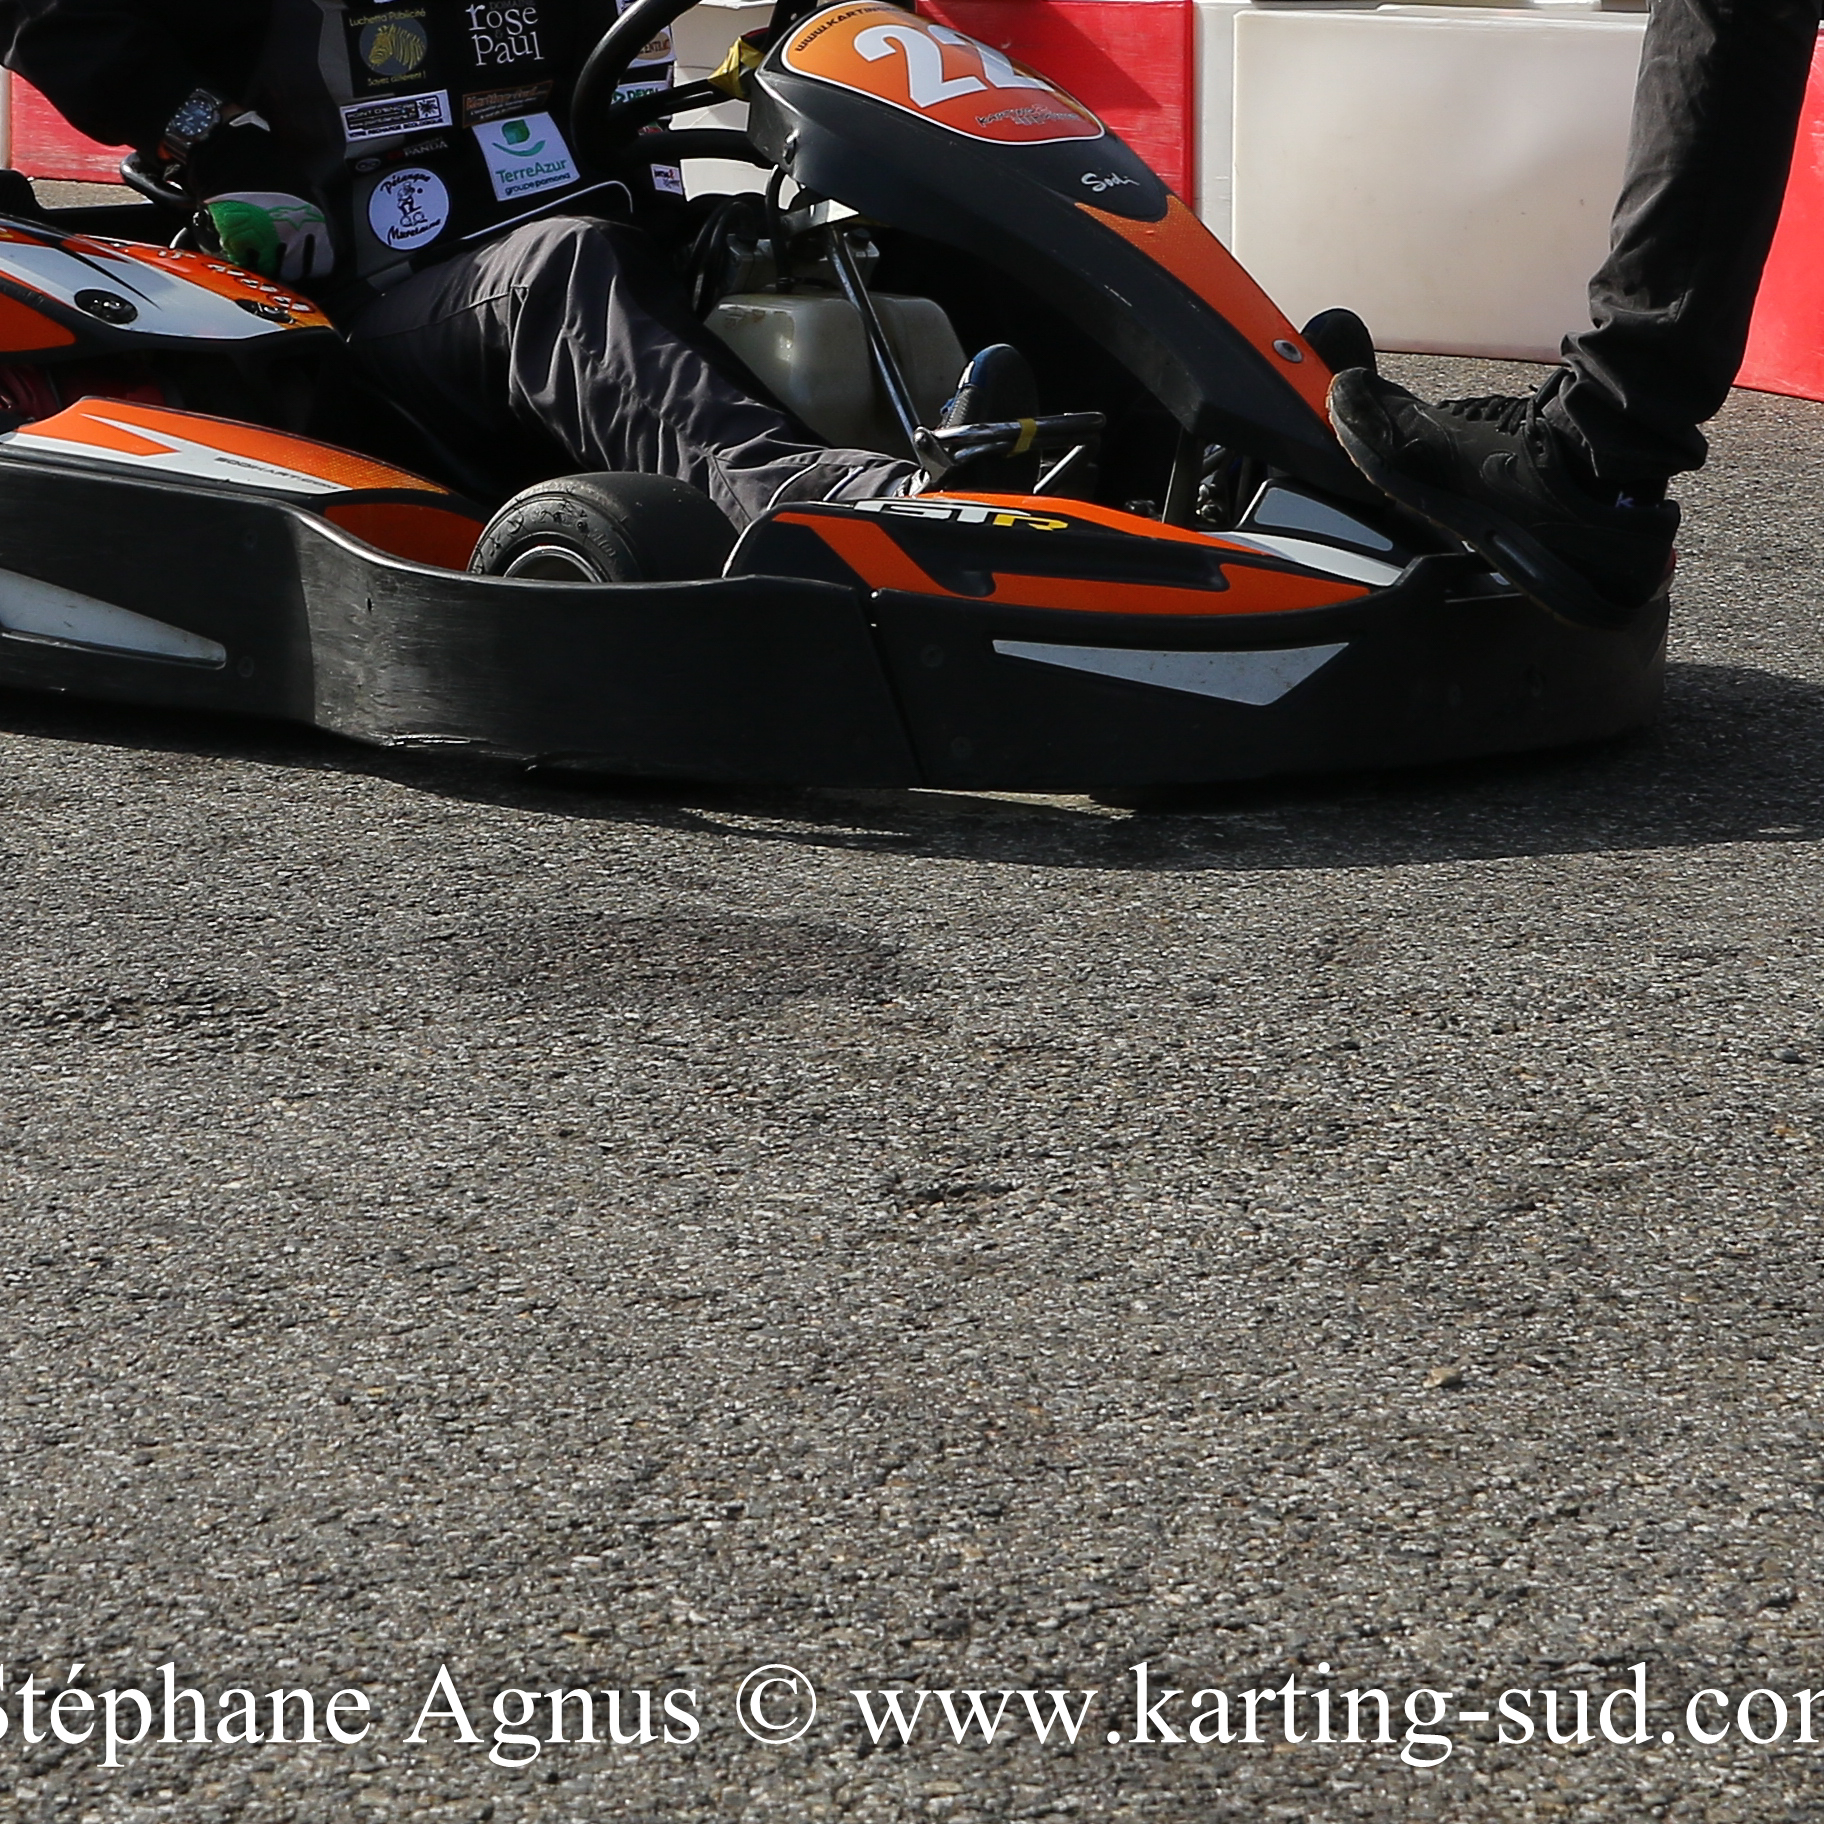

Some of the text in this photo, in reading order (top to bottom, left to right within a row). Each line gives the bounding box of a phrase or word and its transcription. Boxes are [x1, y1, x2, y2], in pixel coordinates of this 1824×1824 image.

[465, 3, 540, 36] rose
[472, 31, 545, 66] Paul
[853, 24, 1054, 108] 22
[495, 159, 568, 185] TerreAzur
[504, 172, 571, 196] groupe pomona
[1081, 172, 1141, 193] Sodi
